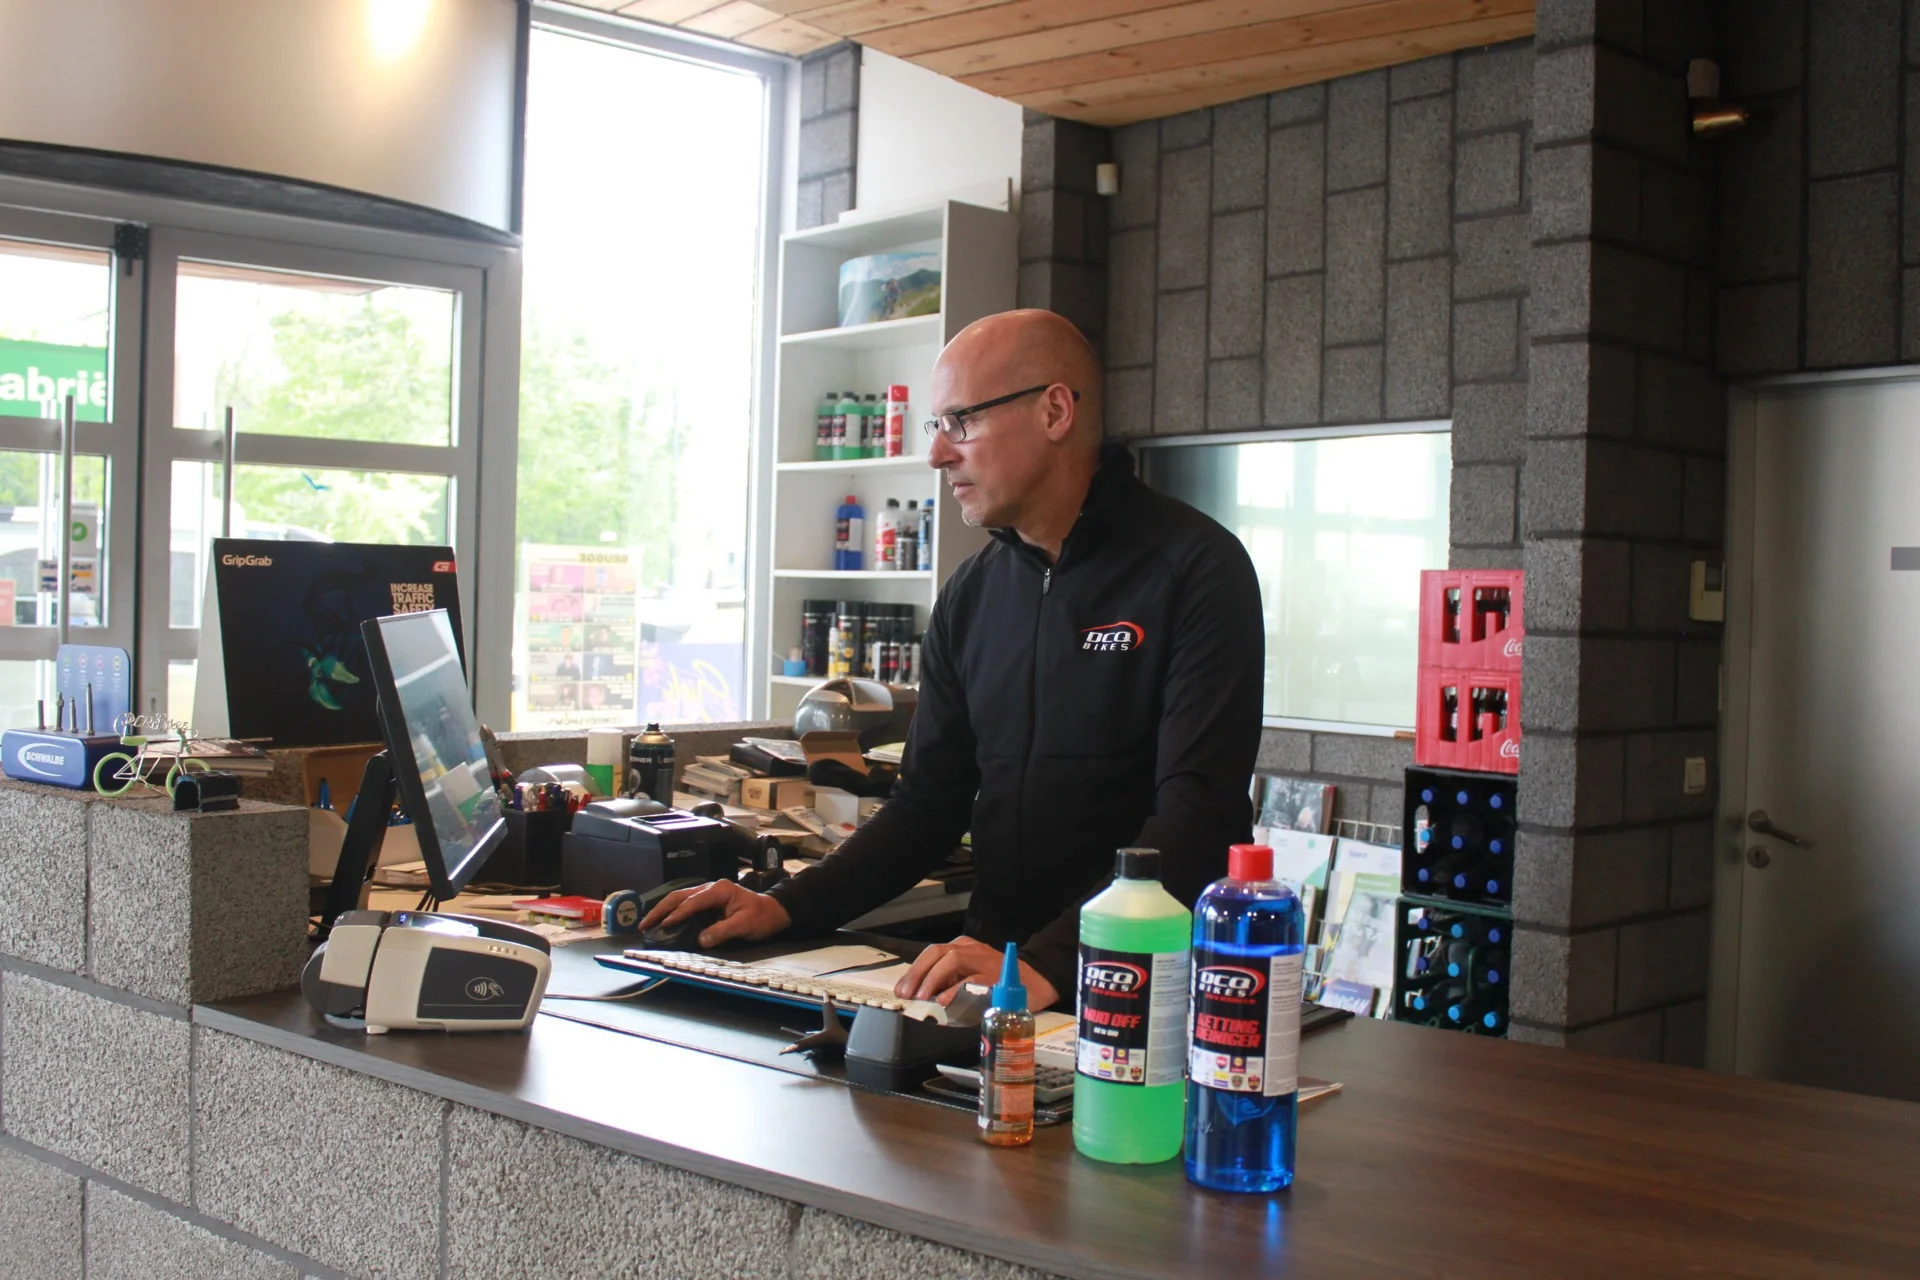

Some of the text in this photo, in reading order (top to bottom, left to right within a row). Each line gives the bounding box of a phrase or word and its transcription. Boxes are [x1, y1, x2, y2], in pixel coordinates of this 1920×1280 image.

[222, 554, 272, 567] GripGrab
[390, 583, 434, 592] INCREASE
[391, 592, 434, 603] TRAFFIC
[1086, 631, 1132, 643] DCQ
[1082, 642, 1130, 651] BIKES
[26, 751, 65, 766] SCHWALBE
[1086, 966, 1134, 984] DCQ
[1201, 971, 1251, 989] DCQ
[1085, 977, 1130, 992] BIKES
[1199, 983, 1247, 998] BIKES
[1111, 1014, 1141, 1029] OFF
